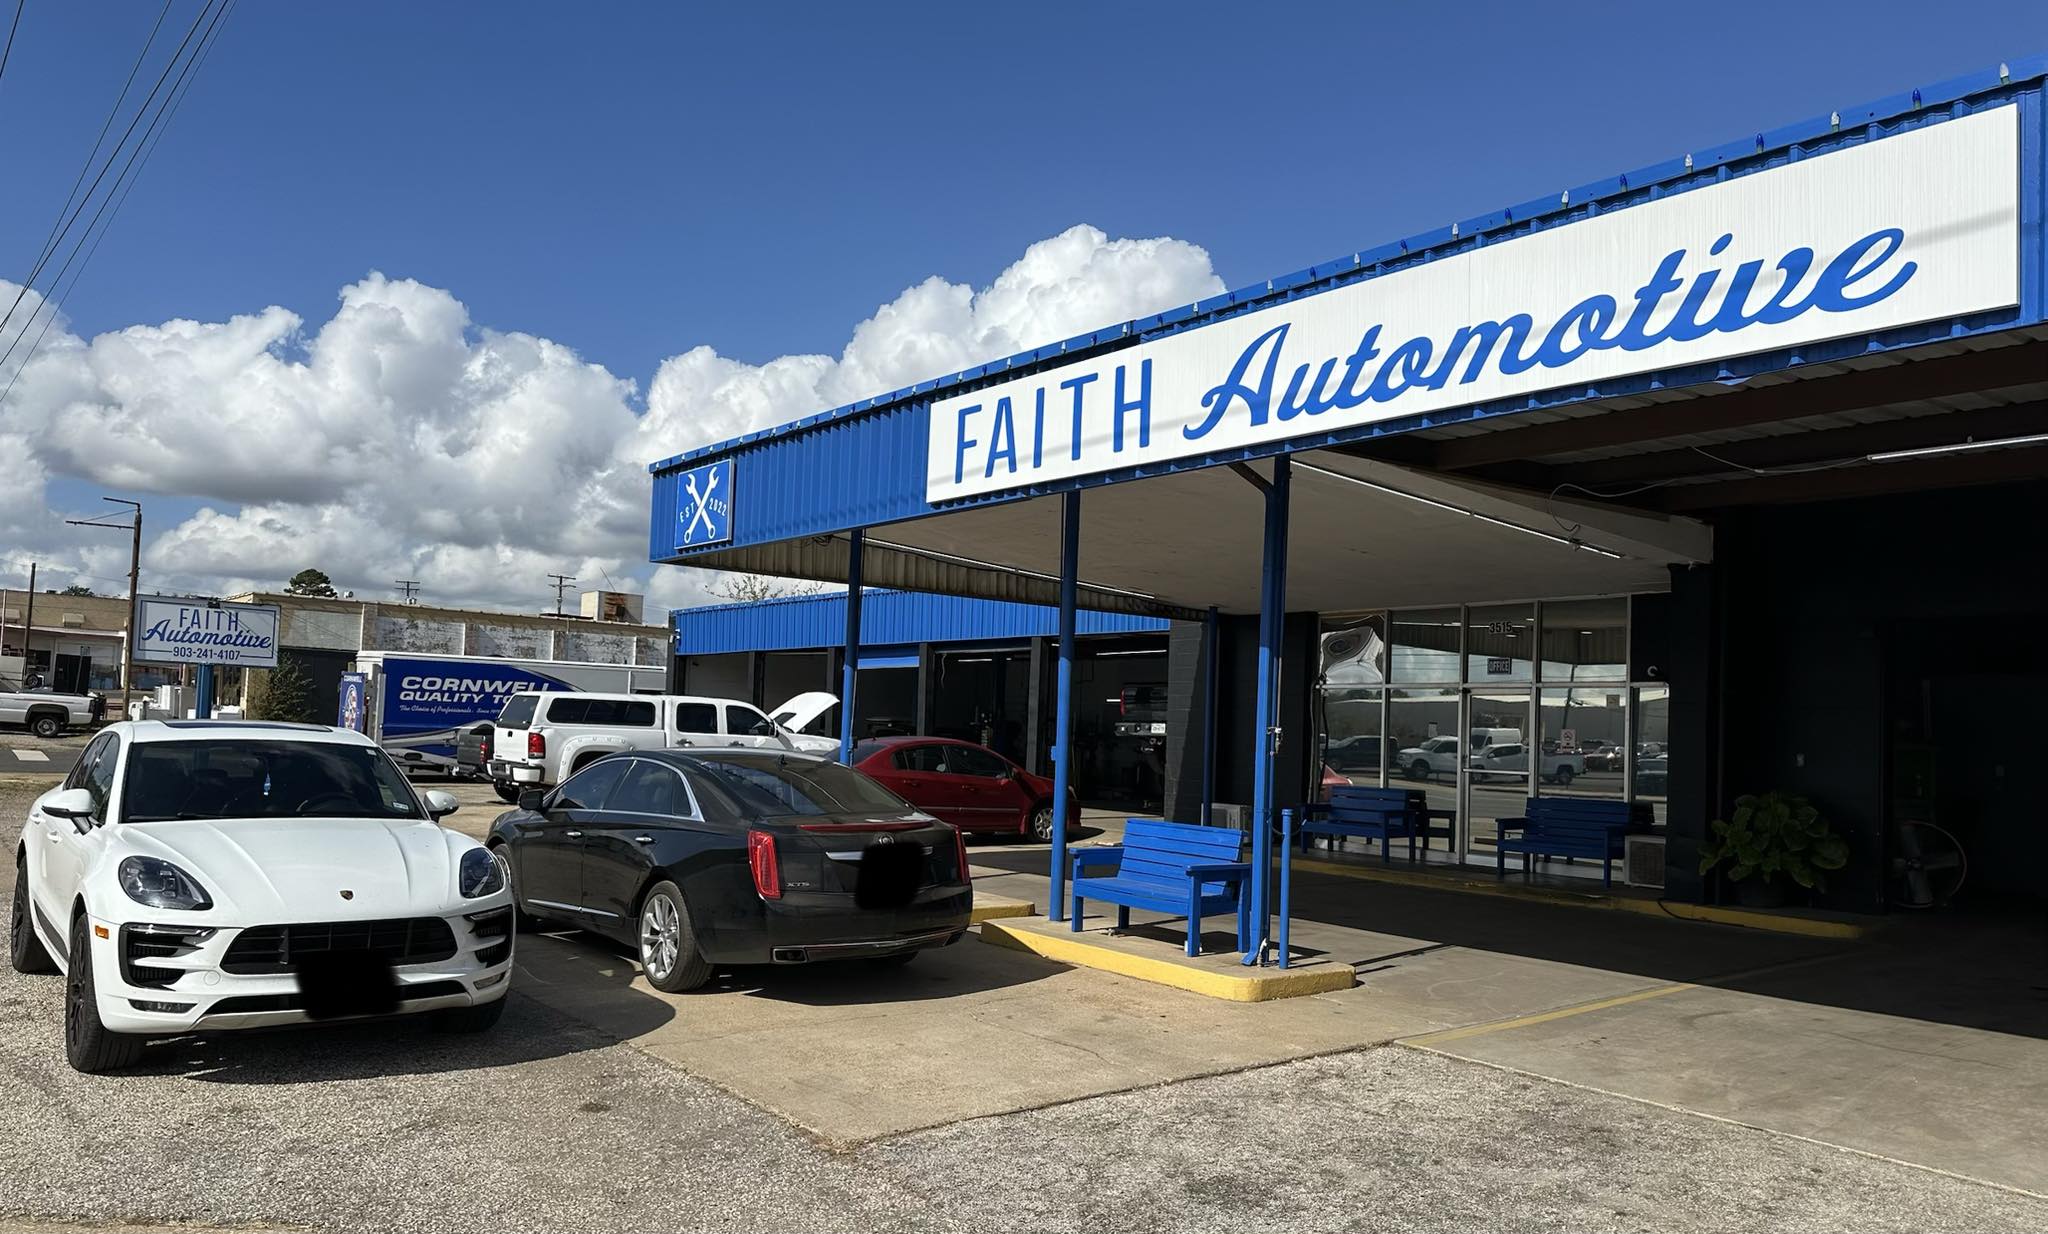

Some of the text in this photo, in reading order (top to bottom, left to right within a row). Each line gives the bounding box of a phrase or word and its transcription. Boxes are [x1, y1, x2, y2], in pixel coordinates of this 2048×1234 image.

[955, 227, 1918, 485] FAITH Automotive
[680, 498, 727, 524] EST 2022
[179, 608, 239, 632] FAITH
[1489, 621, 1512, 633] 3515
[142, 619, 272, 649] Automotive
[173, 646, 241, 661] 903-241-4107
[1488, 660, 1510, 672] OFFICE
[400, 691, 485, 704] QUALITY
